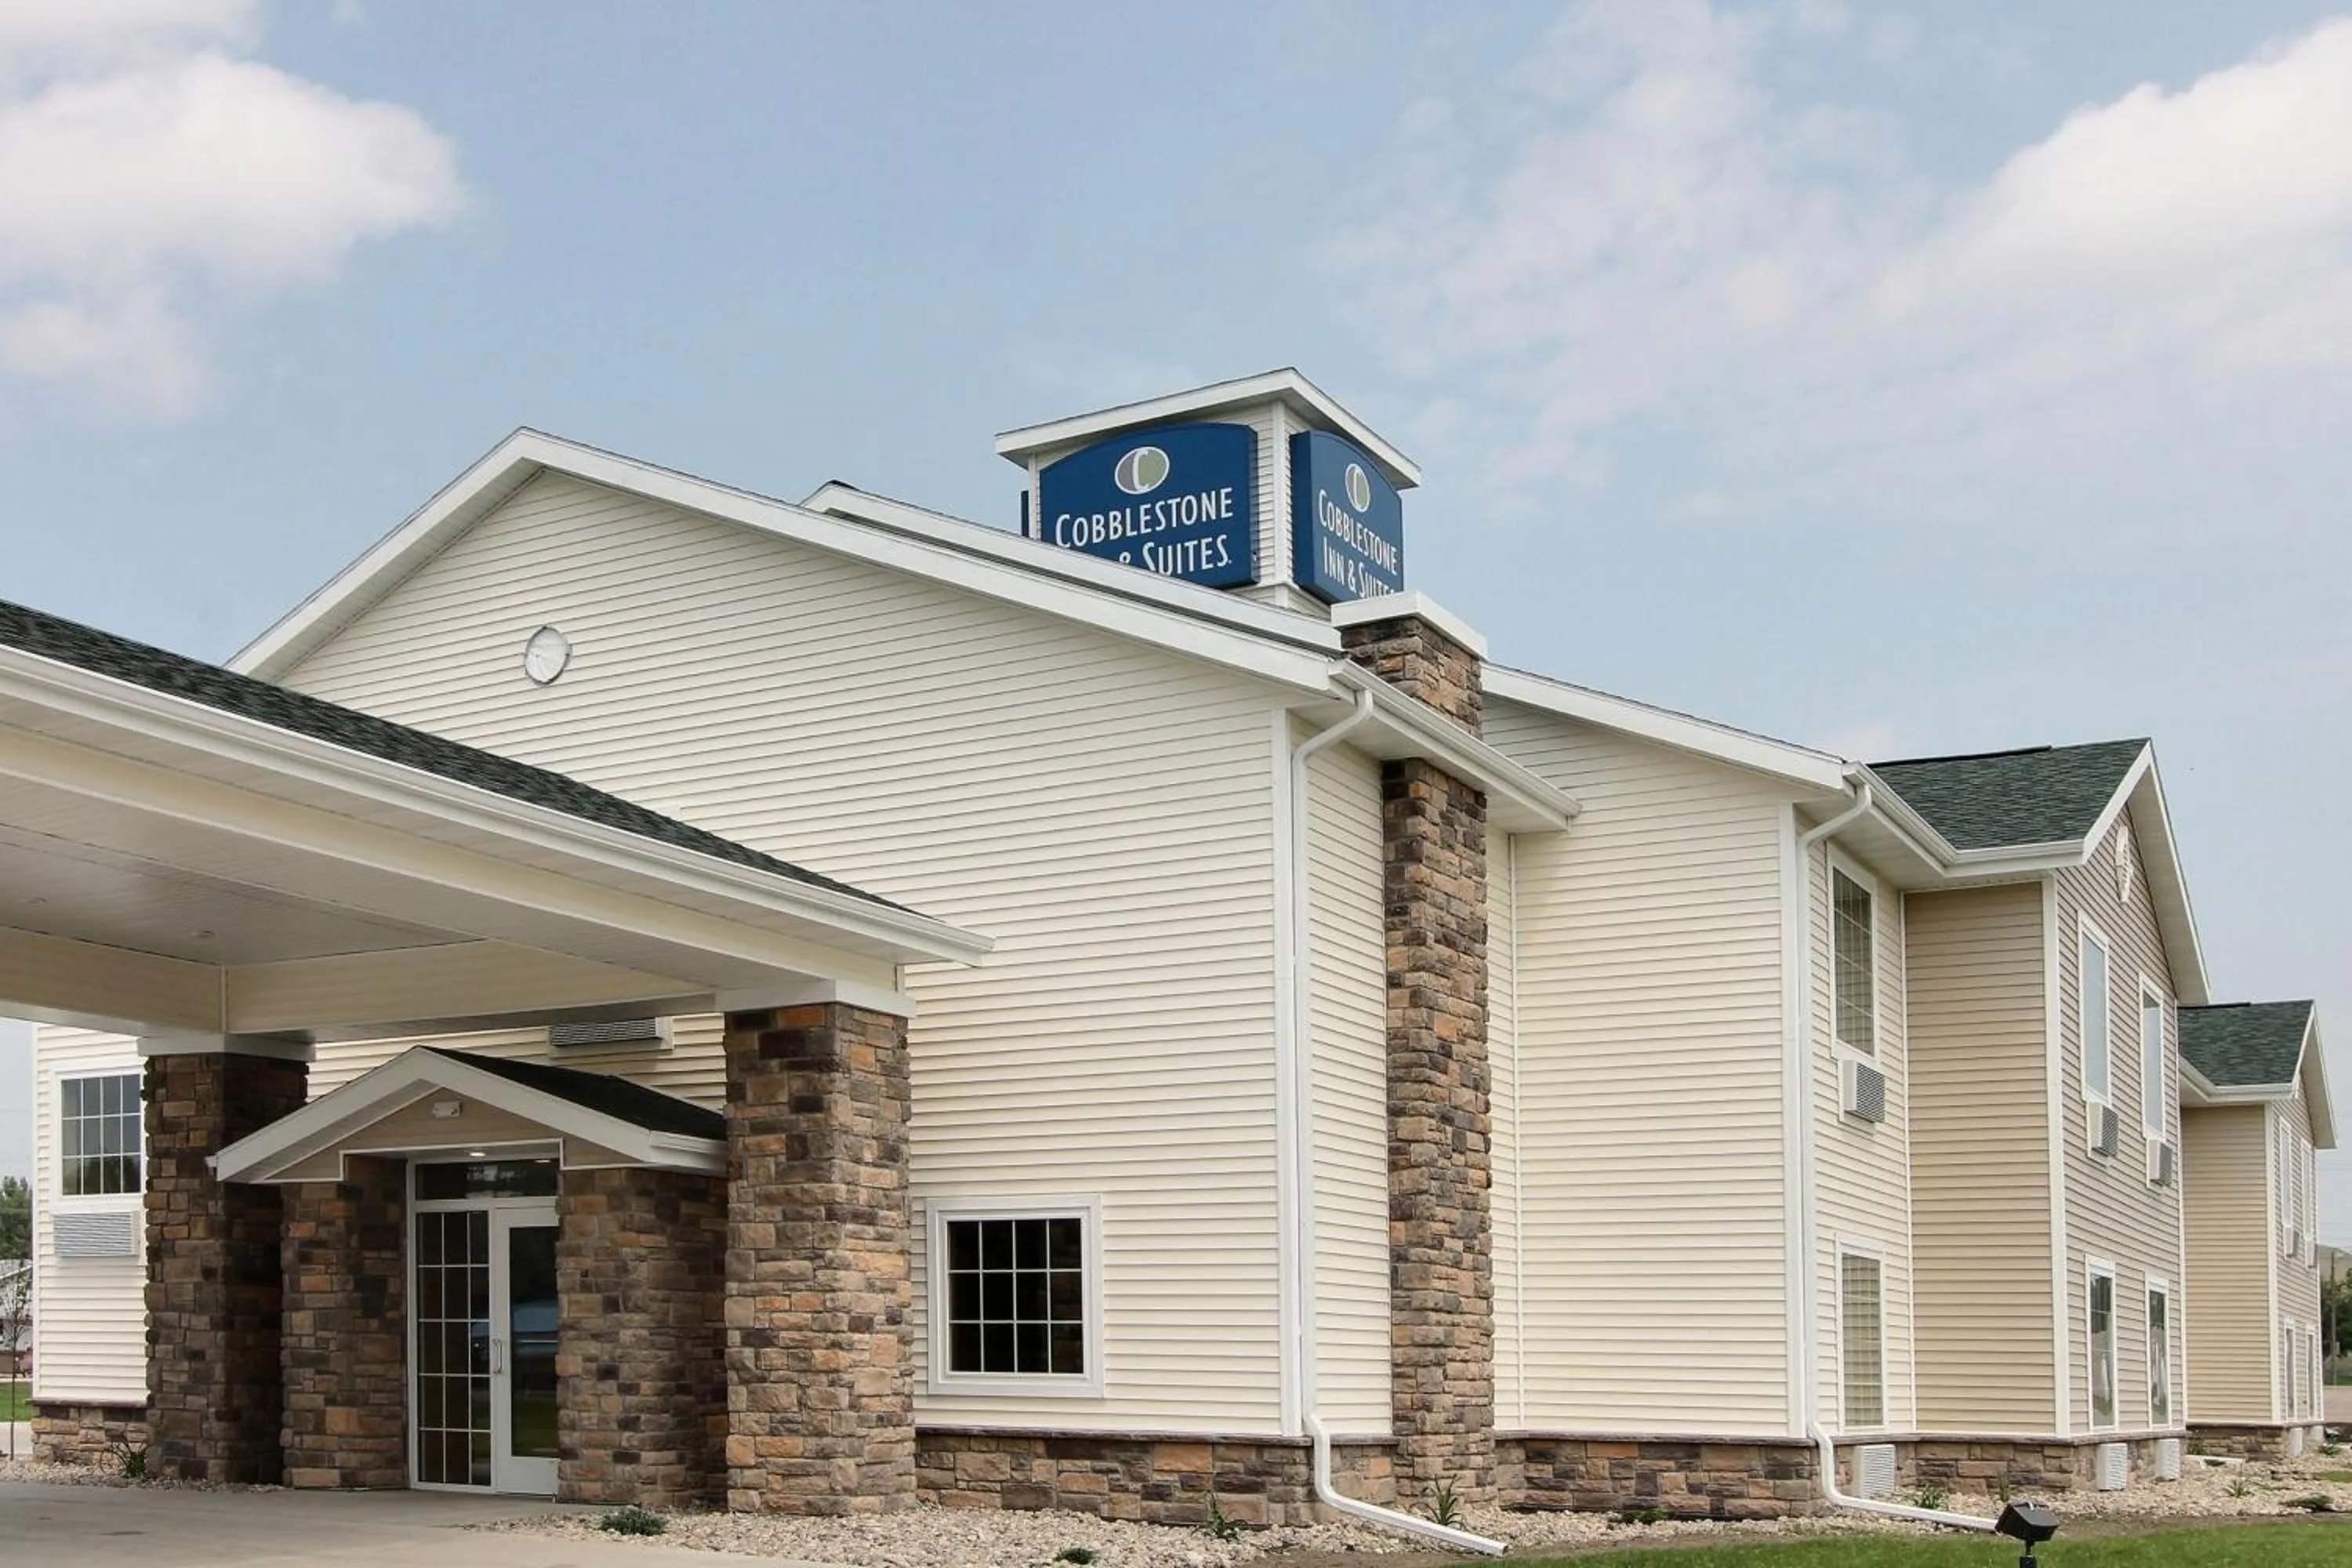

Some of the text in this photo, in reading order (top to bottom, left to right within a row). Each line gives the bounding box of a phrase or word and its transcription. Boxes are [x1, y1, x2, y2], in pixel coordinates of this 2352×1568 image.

[1054, 487, 1234, 549] COBBLESTONE
[1319, 489, 1397, 575] COBBLESTONE
[1323, 535, 1345, 586] INN
[1348, 559, 1357, 593] &
